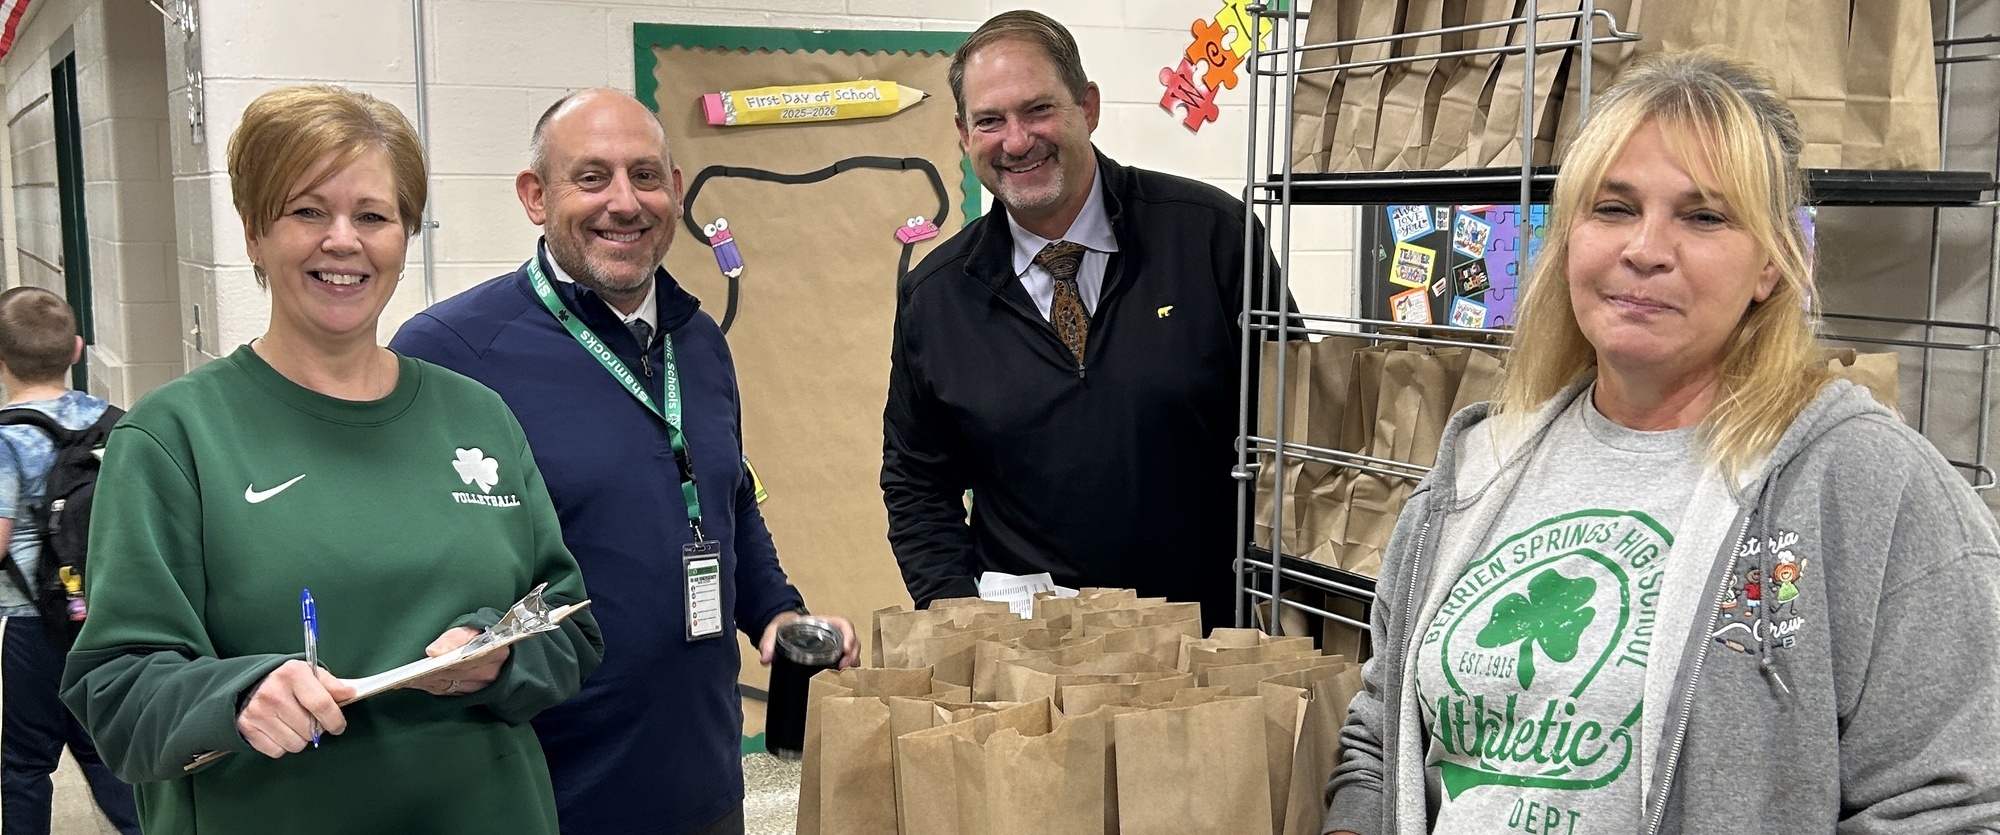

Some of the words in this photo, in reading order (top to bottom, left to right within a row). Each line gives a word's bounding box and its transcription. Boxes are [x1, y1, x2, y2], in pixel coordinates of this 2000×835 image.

[746, 95, 780, 108] First
[814, 90, 830, 103] of
[835, 87, 881, 101] School
[782, 106, 836, 119] 2025-2026
[665, 333, 674, 360] ublic
[666, 360, 679, 410] Schools
[451, 492, 521, 508] VOLLEYBALL
[1424, 556, 1508, 645] BERRIEN
[1513, 521, 1619, 564] SPRINGS
[1429, 693, 1609, 767] Athletic
